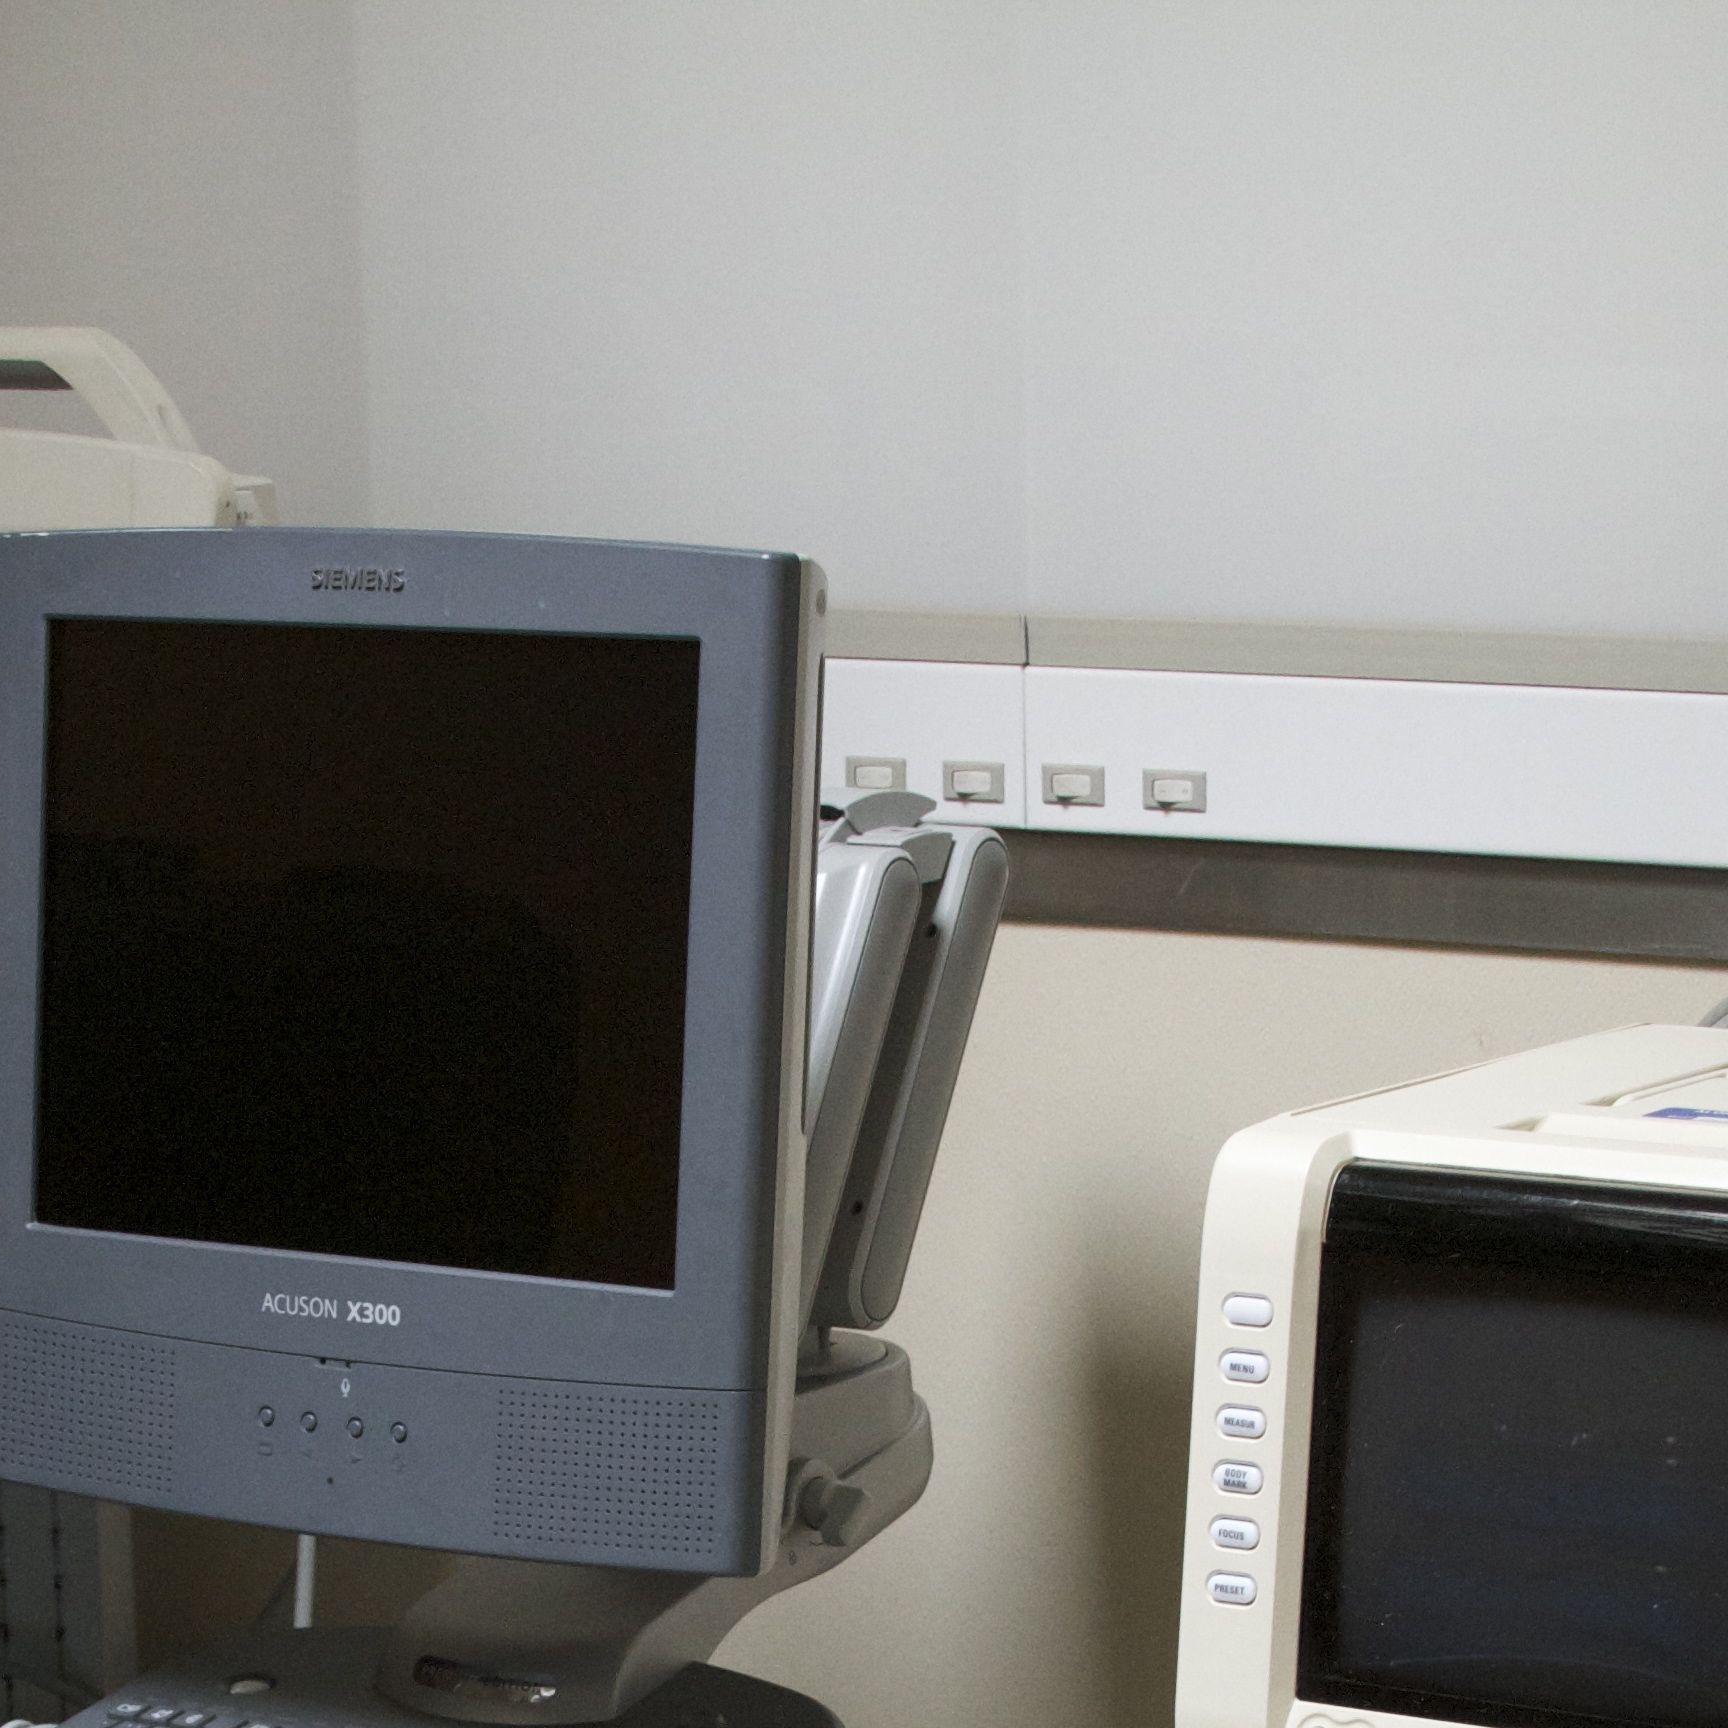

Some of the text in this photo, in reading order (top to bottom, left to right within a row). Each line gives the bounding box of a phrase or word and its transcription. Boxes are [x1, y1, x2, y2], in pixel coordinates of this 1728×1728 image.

[310, 568, 406, 593] SIEMENS
[261, 1293, 401, 1327] ACUSON X300
[1229, 1362, 1255, 1375] MENU
[1224, 1468, 1248, 1479] BODY
[1223, 1478, 1248, 1490] MARK
[1218, 1528, 1245, 1542] FOCUS
[1214, 1583, 1246, 1596] PRESET
